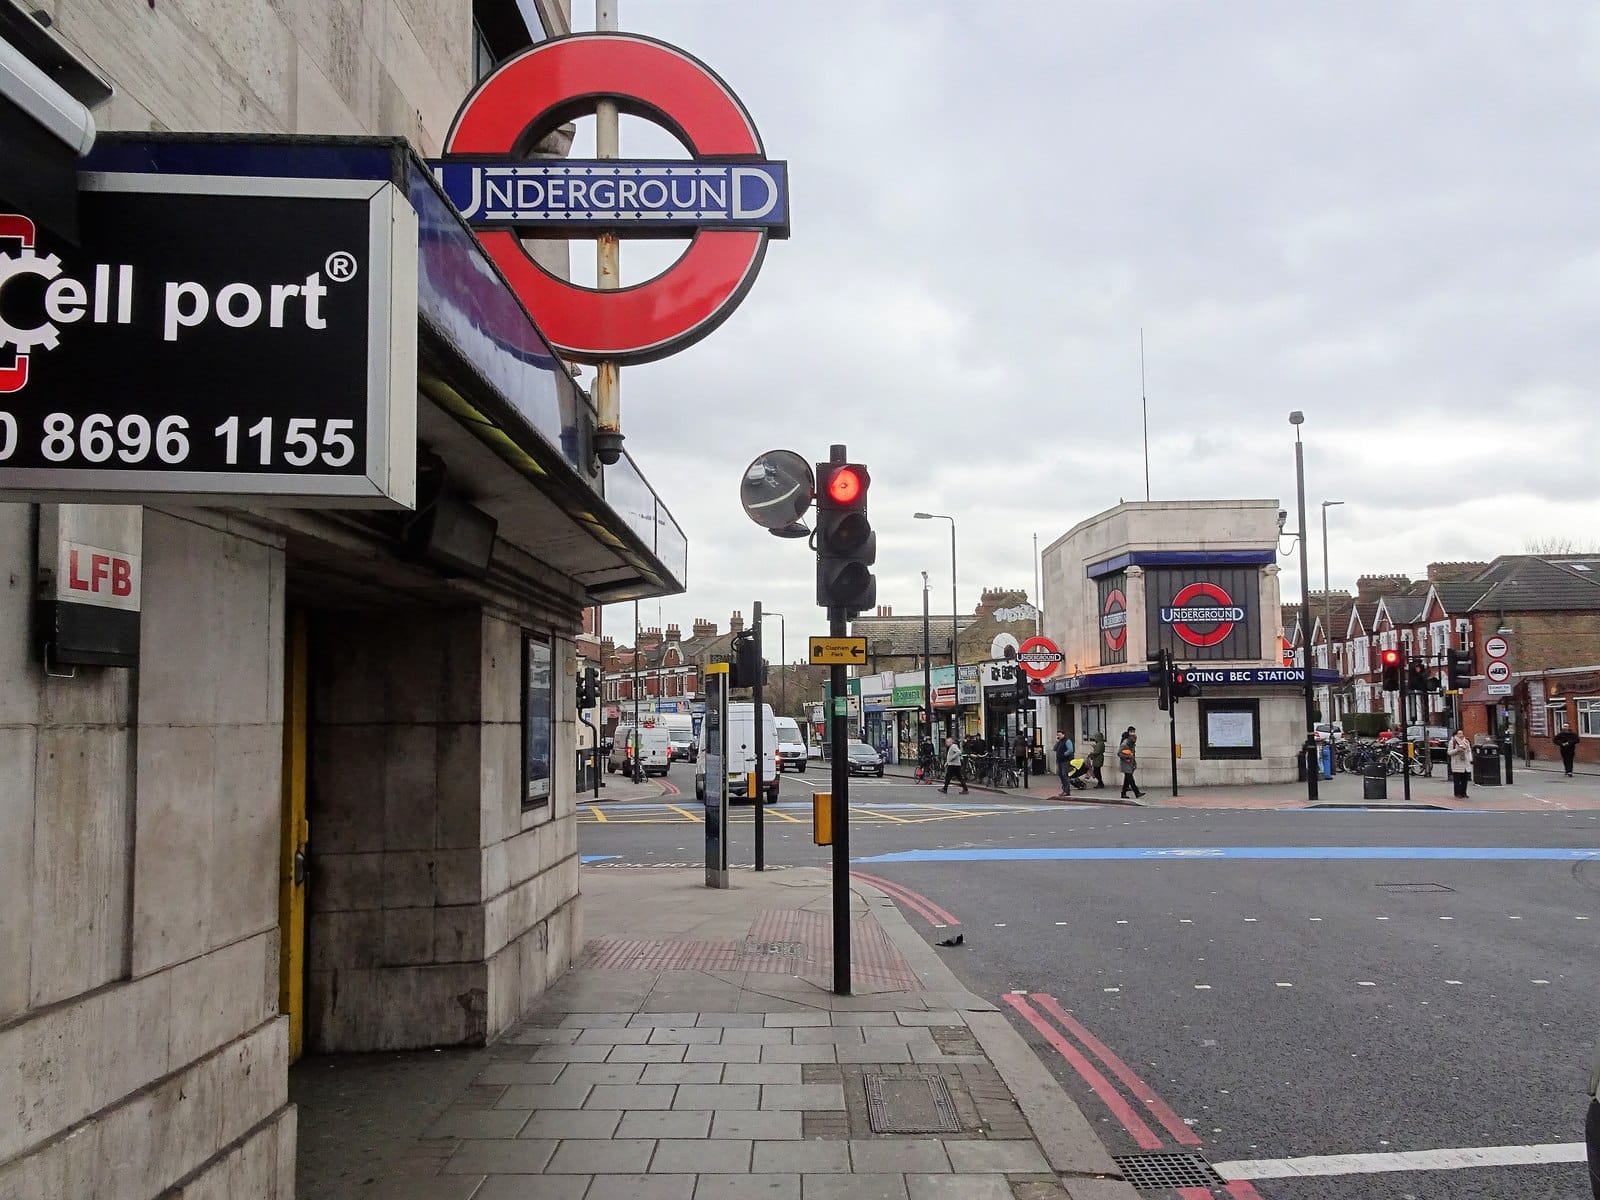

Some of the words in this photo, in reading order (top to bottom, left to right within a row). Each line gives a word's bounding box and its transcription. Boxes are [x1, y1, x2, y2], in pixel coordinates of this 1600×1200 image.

[434, 167, 778, 220] UNDERGROUND
[40, 412, 191, 464] 8696
[214, 415, 356, 467] 1155
[68, 549, 132, 597] LFB
[1161, 608, 1244, 623] UNDERGROUND
[1017, 653, 1062, 662] UNDERGROUND
[1229, 671, 1251, 682] BEC
[1257, 670, 1305, 681] STATION
